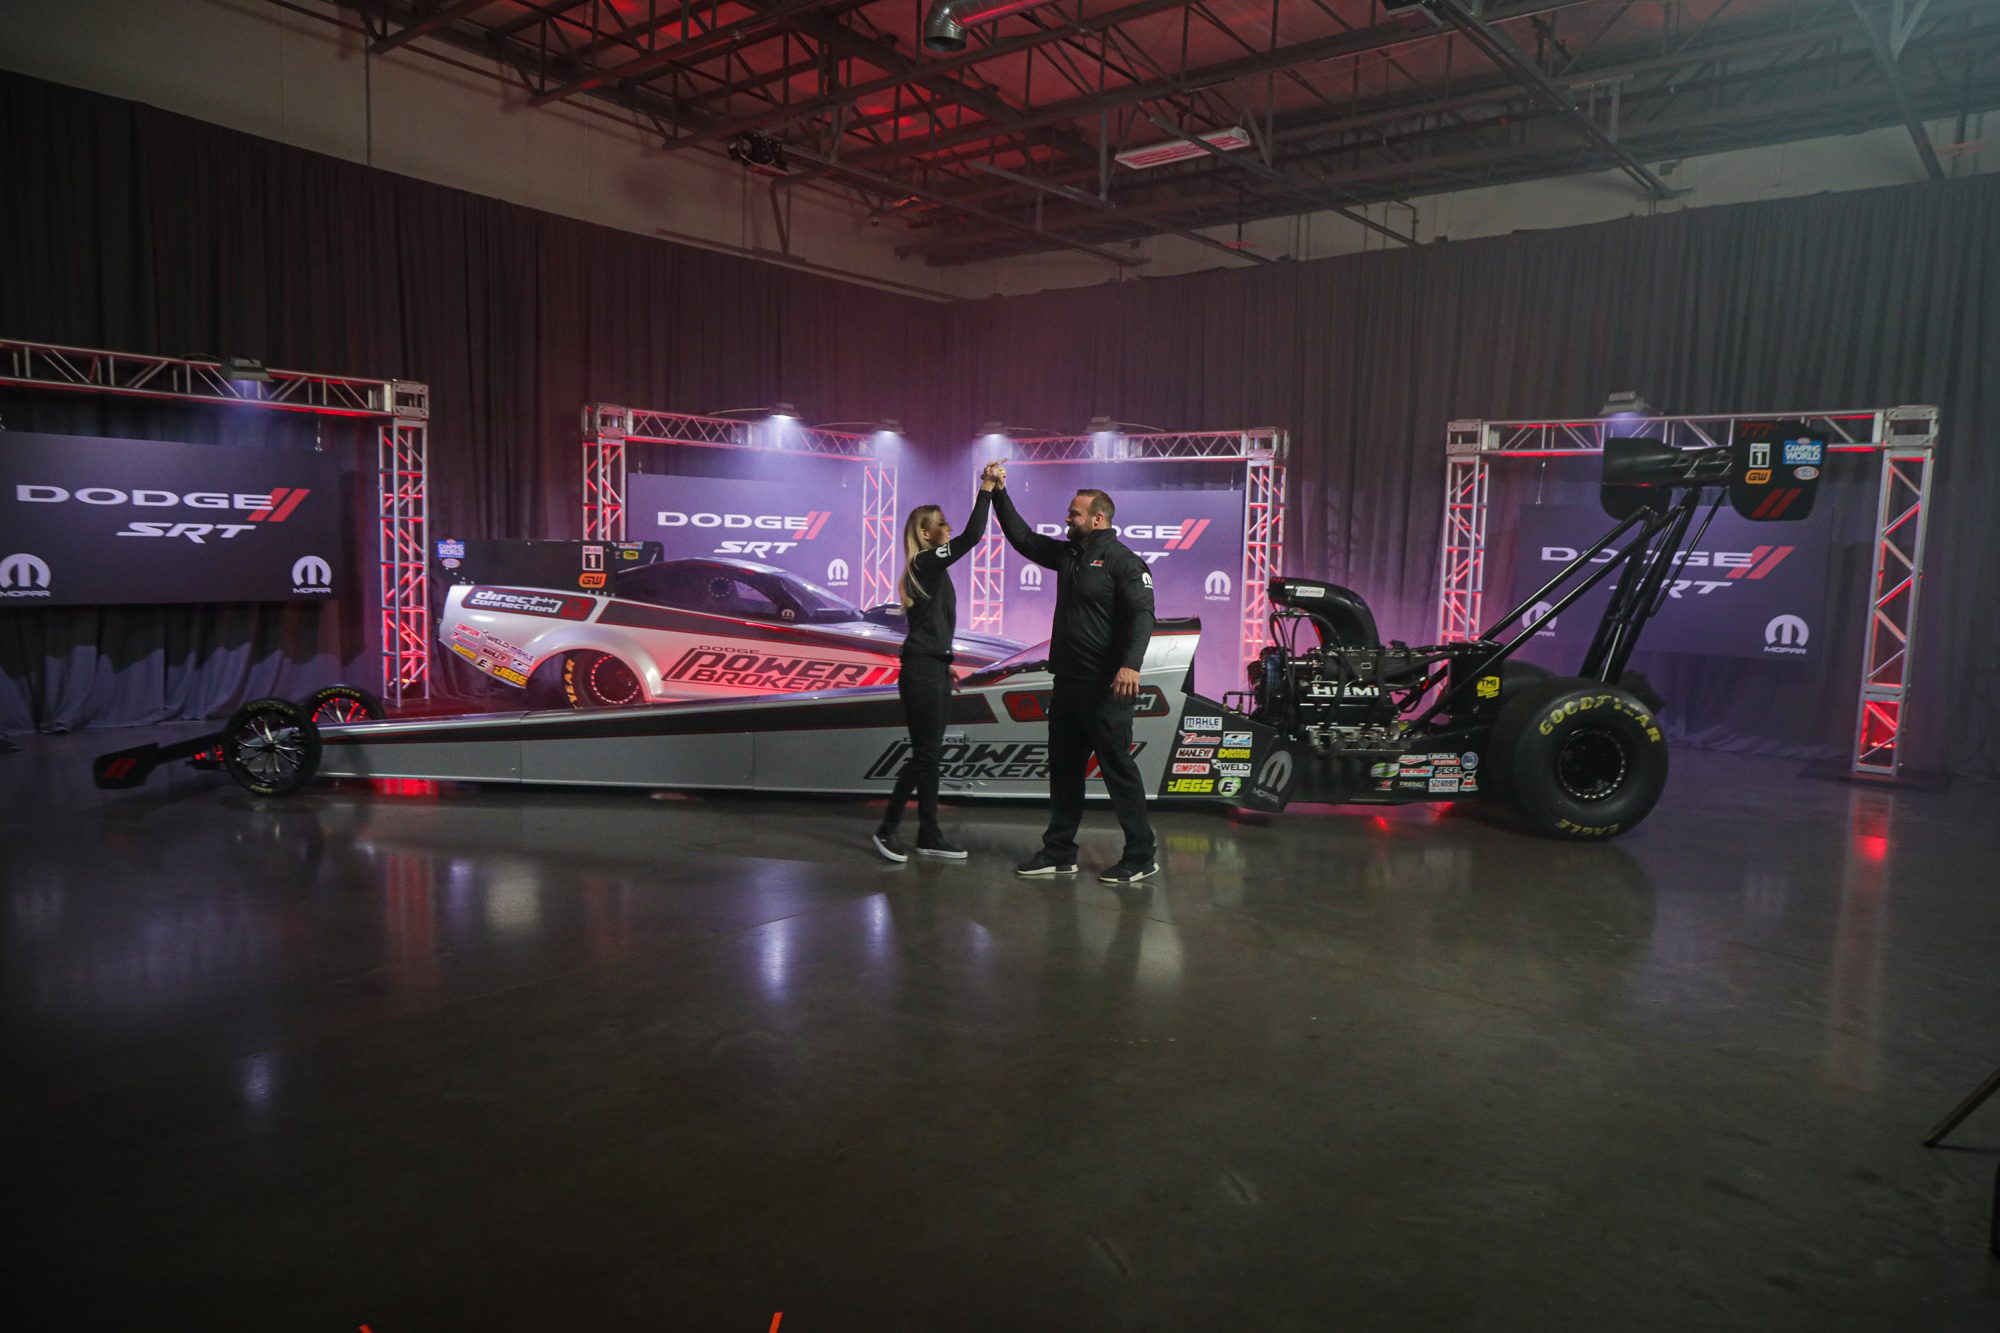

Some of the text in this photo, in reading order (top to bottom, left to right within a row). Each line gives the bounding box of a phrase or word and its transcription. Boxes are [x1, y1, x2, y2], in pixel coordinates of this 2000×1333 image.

[1785, 444, 1821, 453] CAMPING
[1755, 452, 1762, 465] 1
[1786, 451, 1820, 461] WORLD
[16, 484, 274, 511] DODGE
[657, 511, 809, 530] DODGE
[116, 521, 257, 544] SRT
[1036, 523, 1183, 540] DGE
[713, 541, 798, 559] SRT
[1542, 546, 1753, 568] DOGE
[589, 554, 597, 568] 1
[475, 589, 544, 605] direct
[470, 598, 556, 614] connection
[698, 645, 761, 655] DODGE
[1763, 645, 1808, 655] MOPAR
[671, 651, 868, 682] POWER
[1186, 717, 1220, 726] MAHLE
[1178, 748, 1210, 757] MANLEY
[1174, 765, 1207, 773] SIMPSON
[1221, 763, 1250, 771] WELD
[1173, 778, 1215, 793] JEGS
